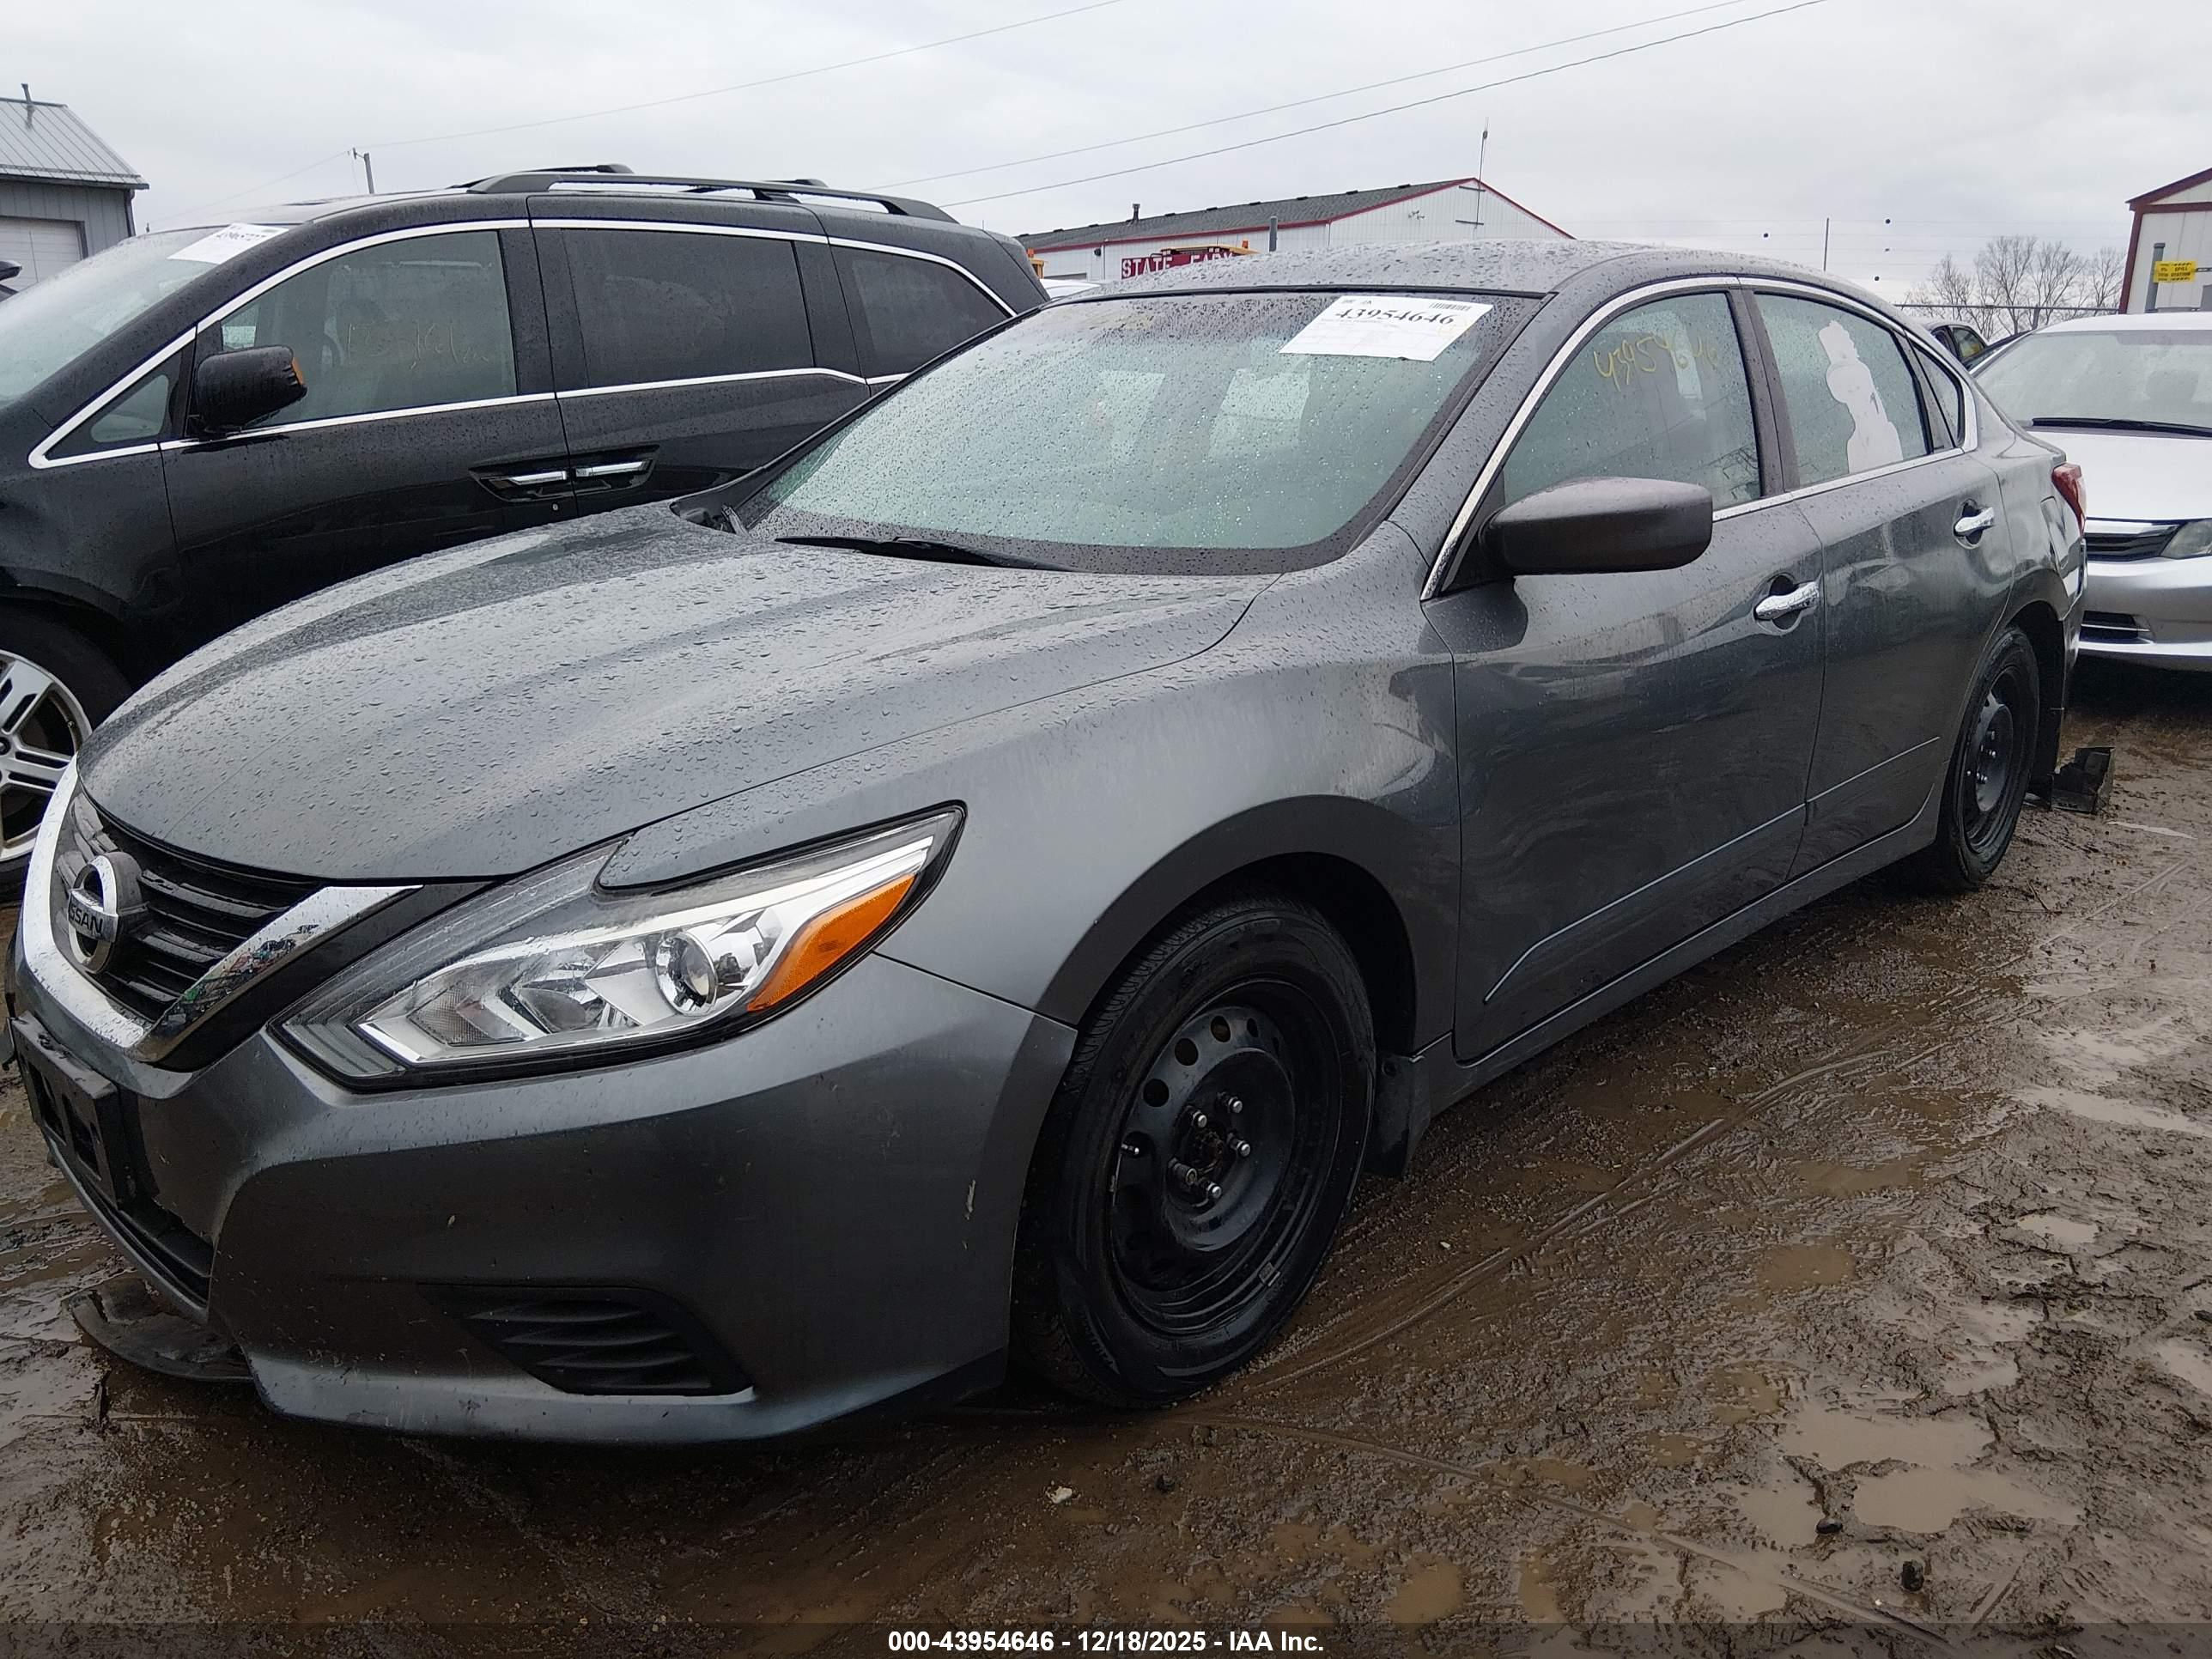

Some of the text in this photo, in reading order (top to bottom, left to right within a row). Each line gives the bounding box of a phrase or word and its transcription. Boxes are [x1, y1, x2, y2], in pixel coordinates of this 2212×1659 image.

[1122, 255, 1174, 278] STATE
[1334, 307, 1455, 325] 43954646
[69, 903, 103, 933] SSAN
